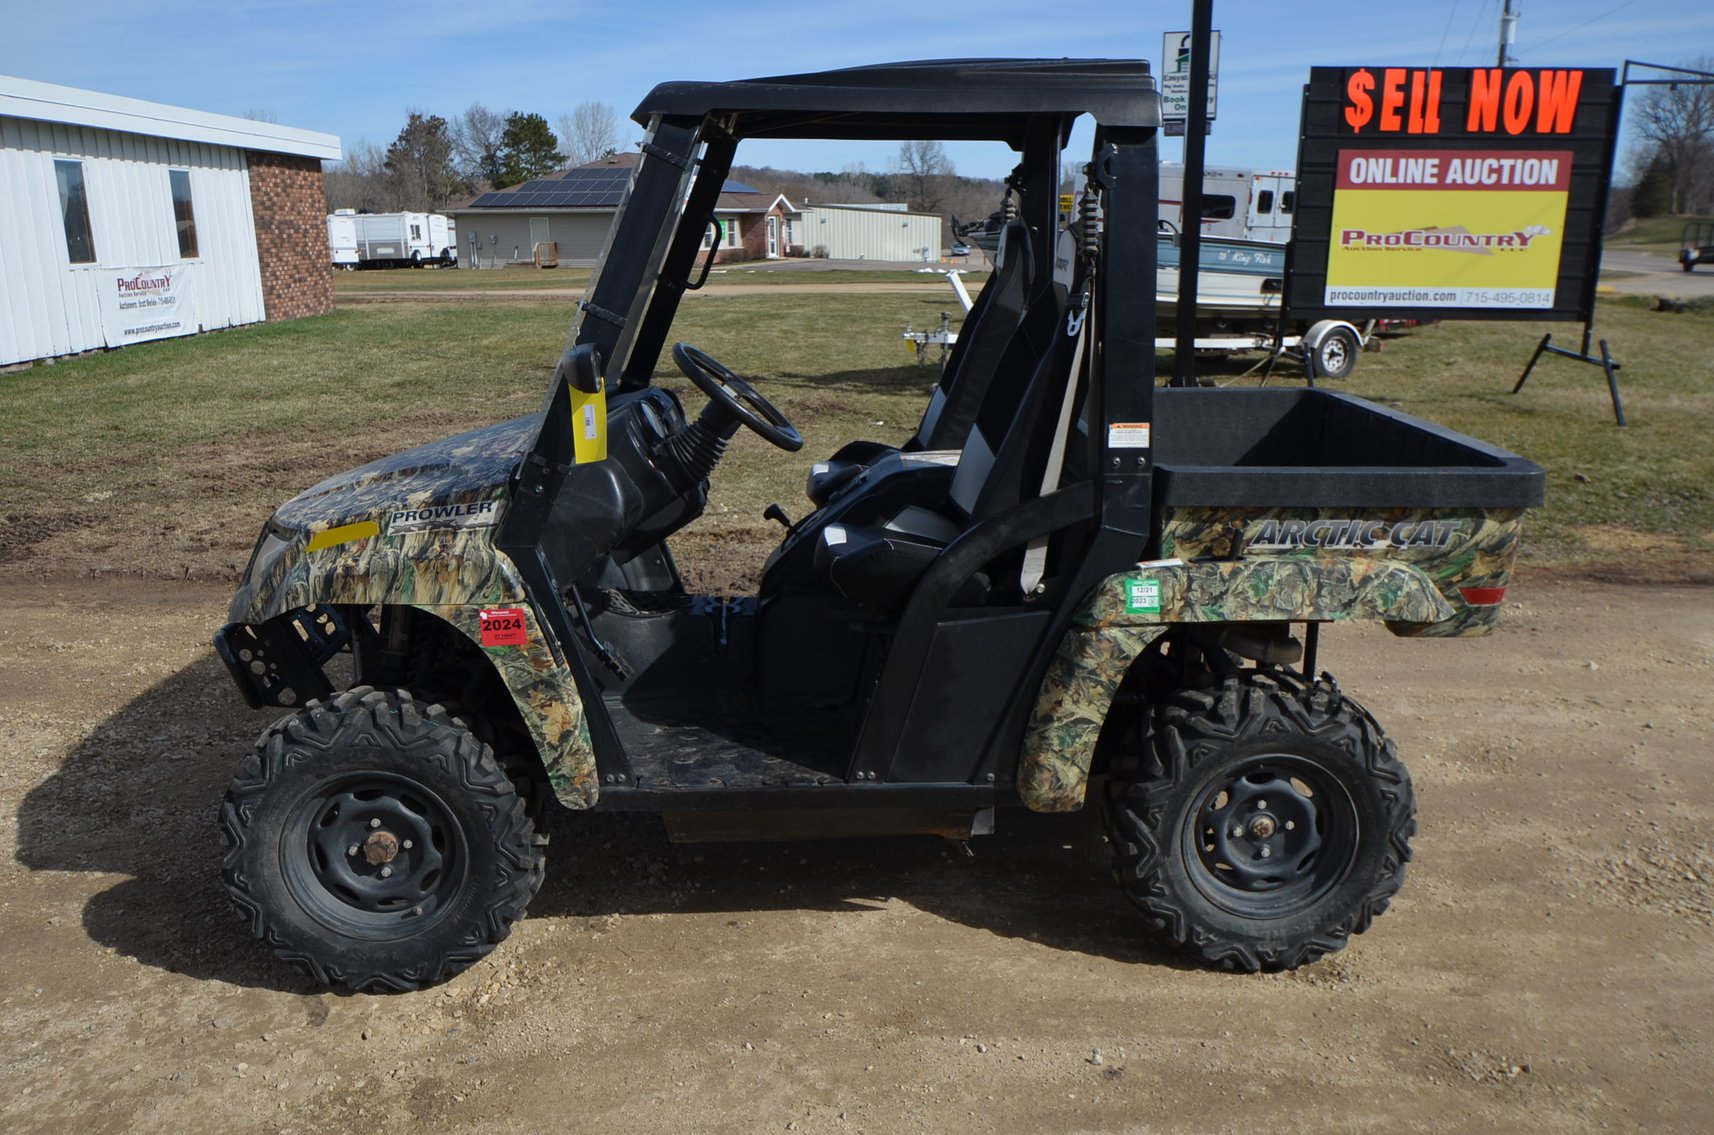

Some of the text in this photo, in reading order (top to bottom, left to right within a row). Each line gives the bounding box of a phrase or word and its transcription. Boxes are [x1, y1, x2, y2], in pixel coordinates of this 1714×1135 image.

[1466, 69, 1583, 135] NOW
[1350, 157, 1558, 185] ONLINE AUCTION
[1232, 251, 1250, 265] King
[1330, 290, 1550, 305] procountryauction.com 715-495-0814
[392, 502, 493, 524] PROWLER
[1249, 519, 1462, 548] ARCTIC CAT
[482, 618, 521, 631] 2024
